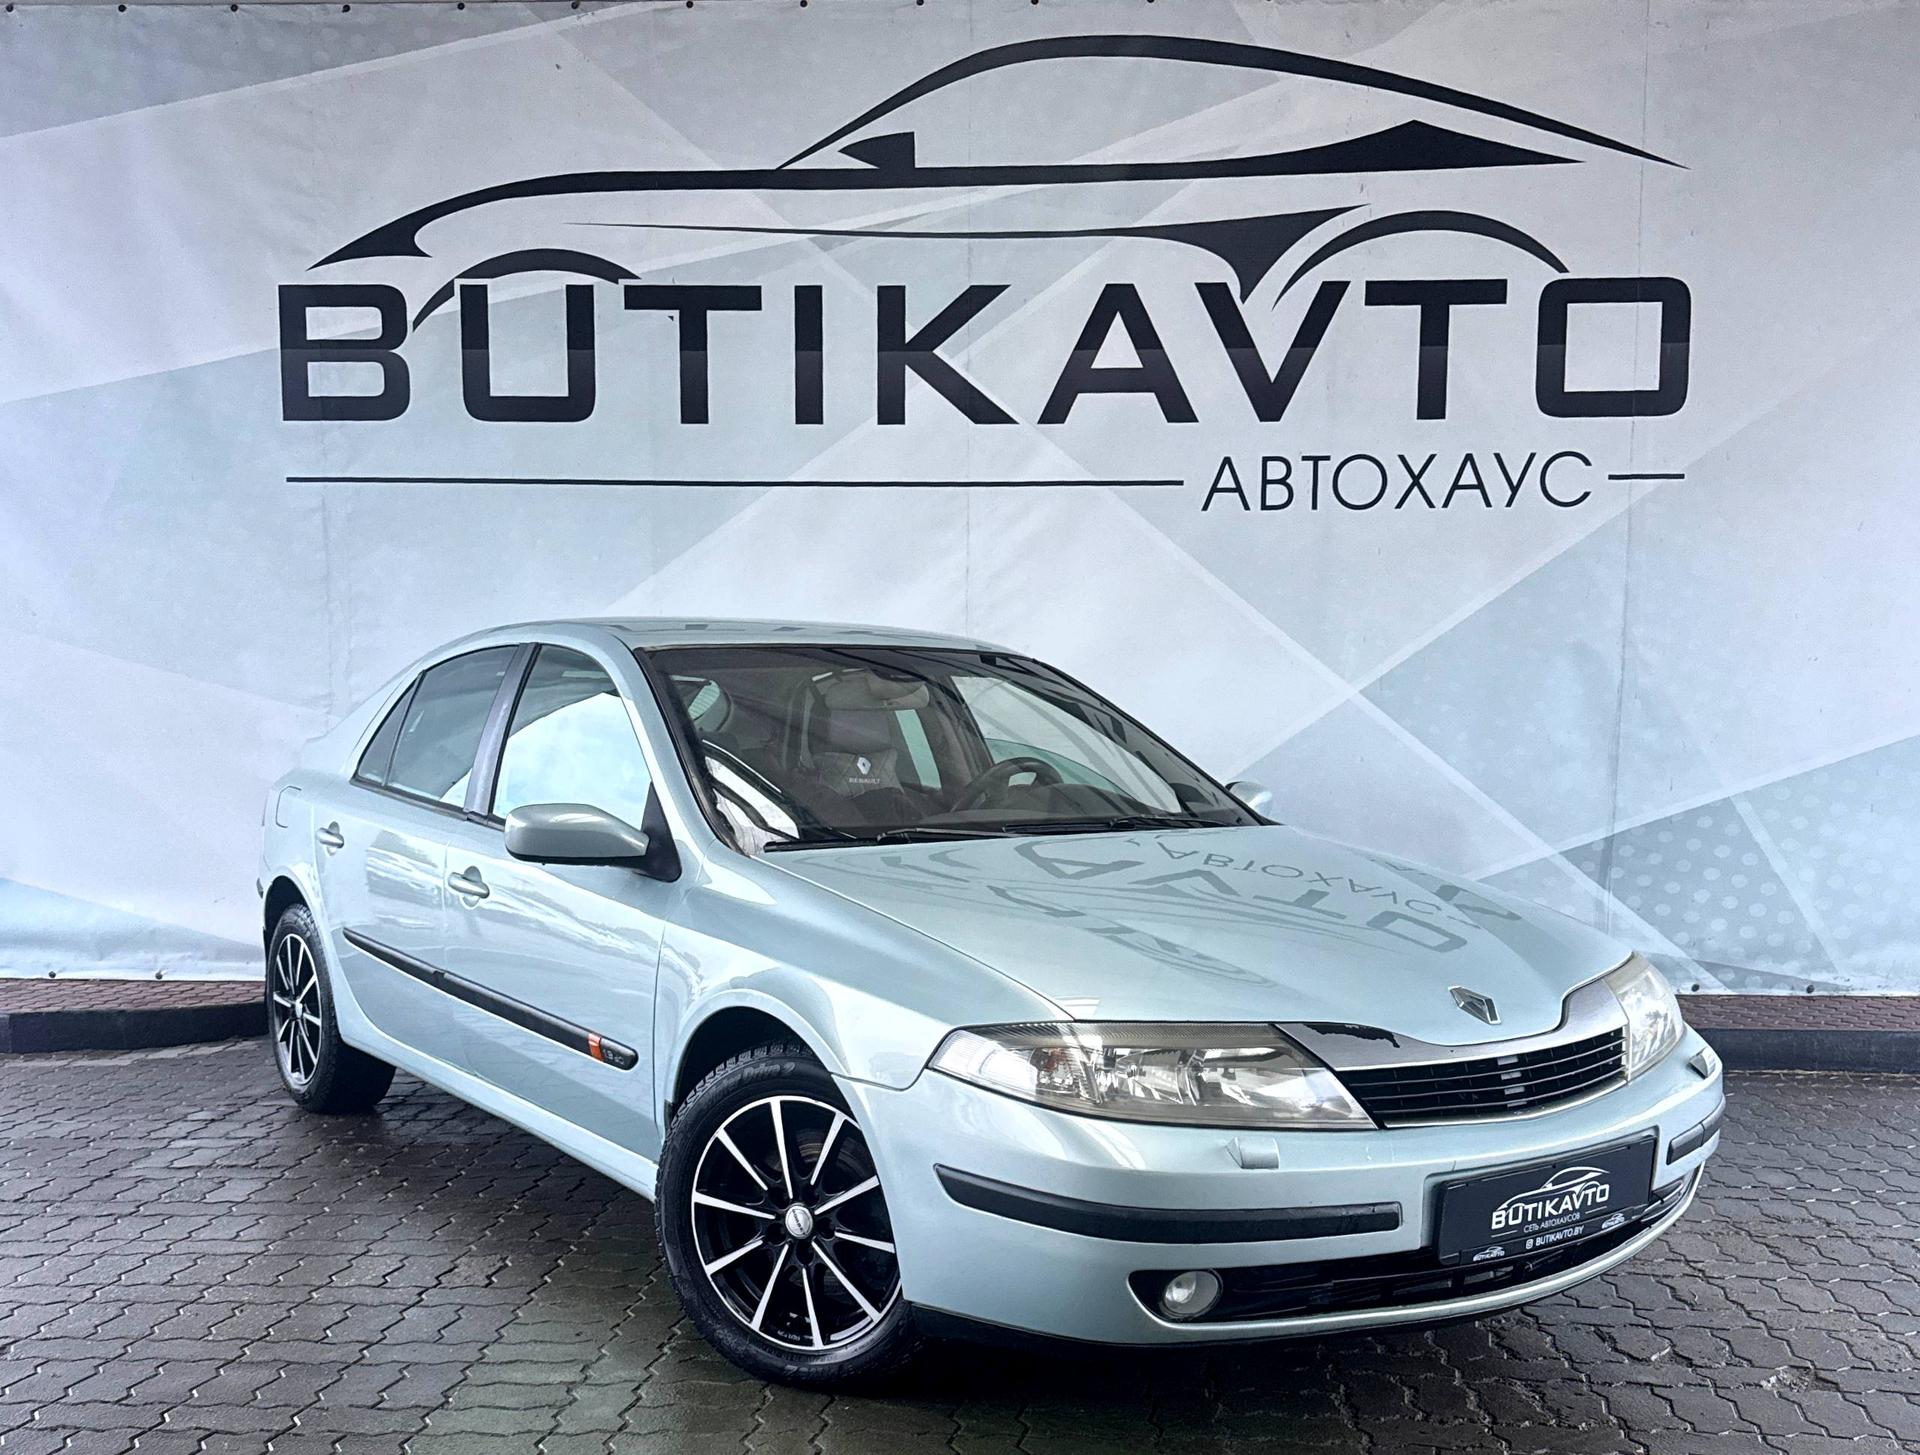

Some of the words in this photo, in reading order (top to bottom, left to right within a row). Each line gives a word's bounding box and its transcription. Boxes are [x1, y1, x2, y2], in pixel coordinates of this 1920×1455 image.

[278, 275, 1692, 425] BUTIKAVTO
[1200, 450, 1594, 512] АВТОХАУС
[1491, 1183, 1611, 1230] BUTIKAVTO
[1535, 1225, 1585, 1247] BUTIKAVTO.BY
